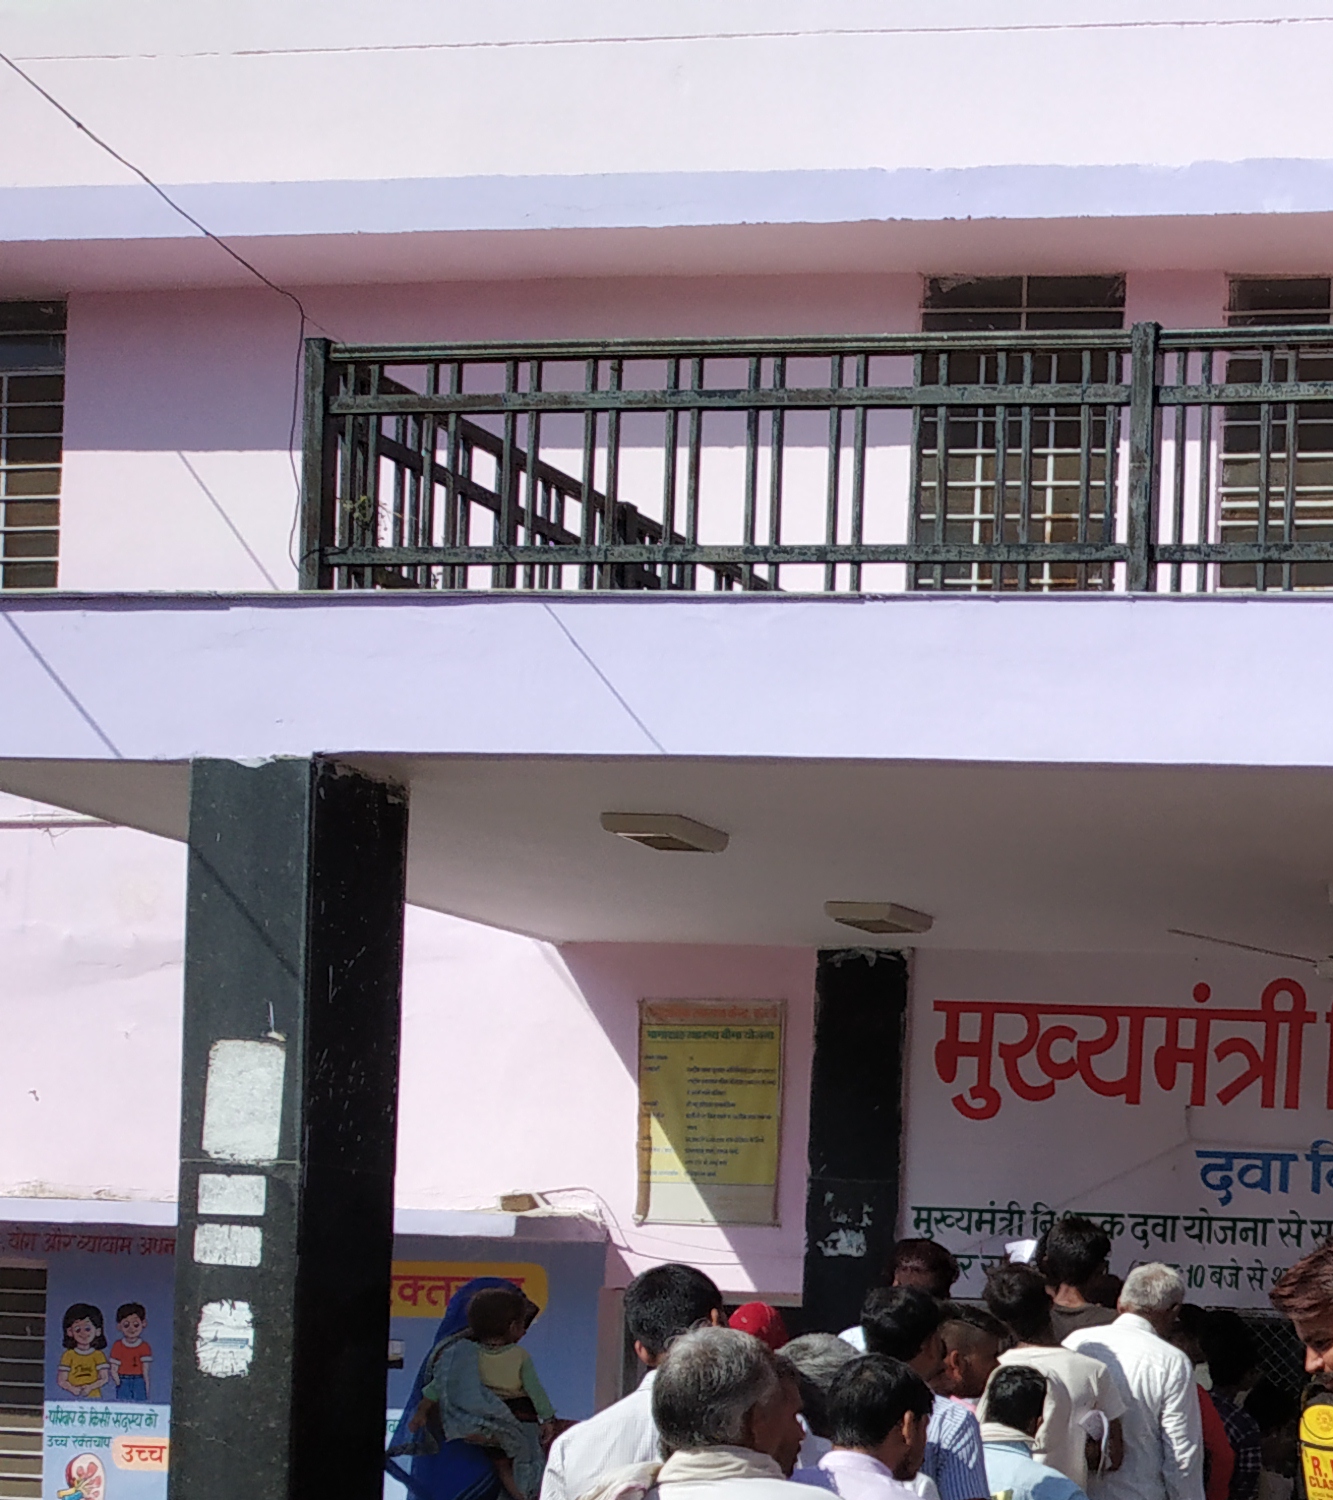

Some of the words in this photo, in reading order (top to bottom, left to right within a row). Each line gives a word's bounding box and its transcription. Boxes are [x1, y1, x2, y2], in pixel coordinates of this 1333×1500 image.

[932, 977, 1317, 1121] मुख्यमंत्री
[1196, 1150, 1299, 1207] दवा
[911, 1200, 1026, 1240] मुख्यमंत्री
[1127, 1213, 1181, 1249] दवा
[1183, 1208, 1275, 1247] योजना
[1277, 1210, 1307, 1248] से
[1186, 1263, 1205, 1289] 10
[1208, 1258, 1243, 1290] बजे
[1246, 1258, 1269, 1291] से
[145, 1408, 159, 1430] को
[122, 1443, 167, 1464] उच्च
